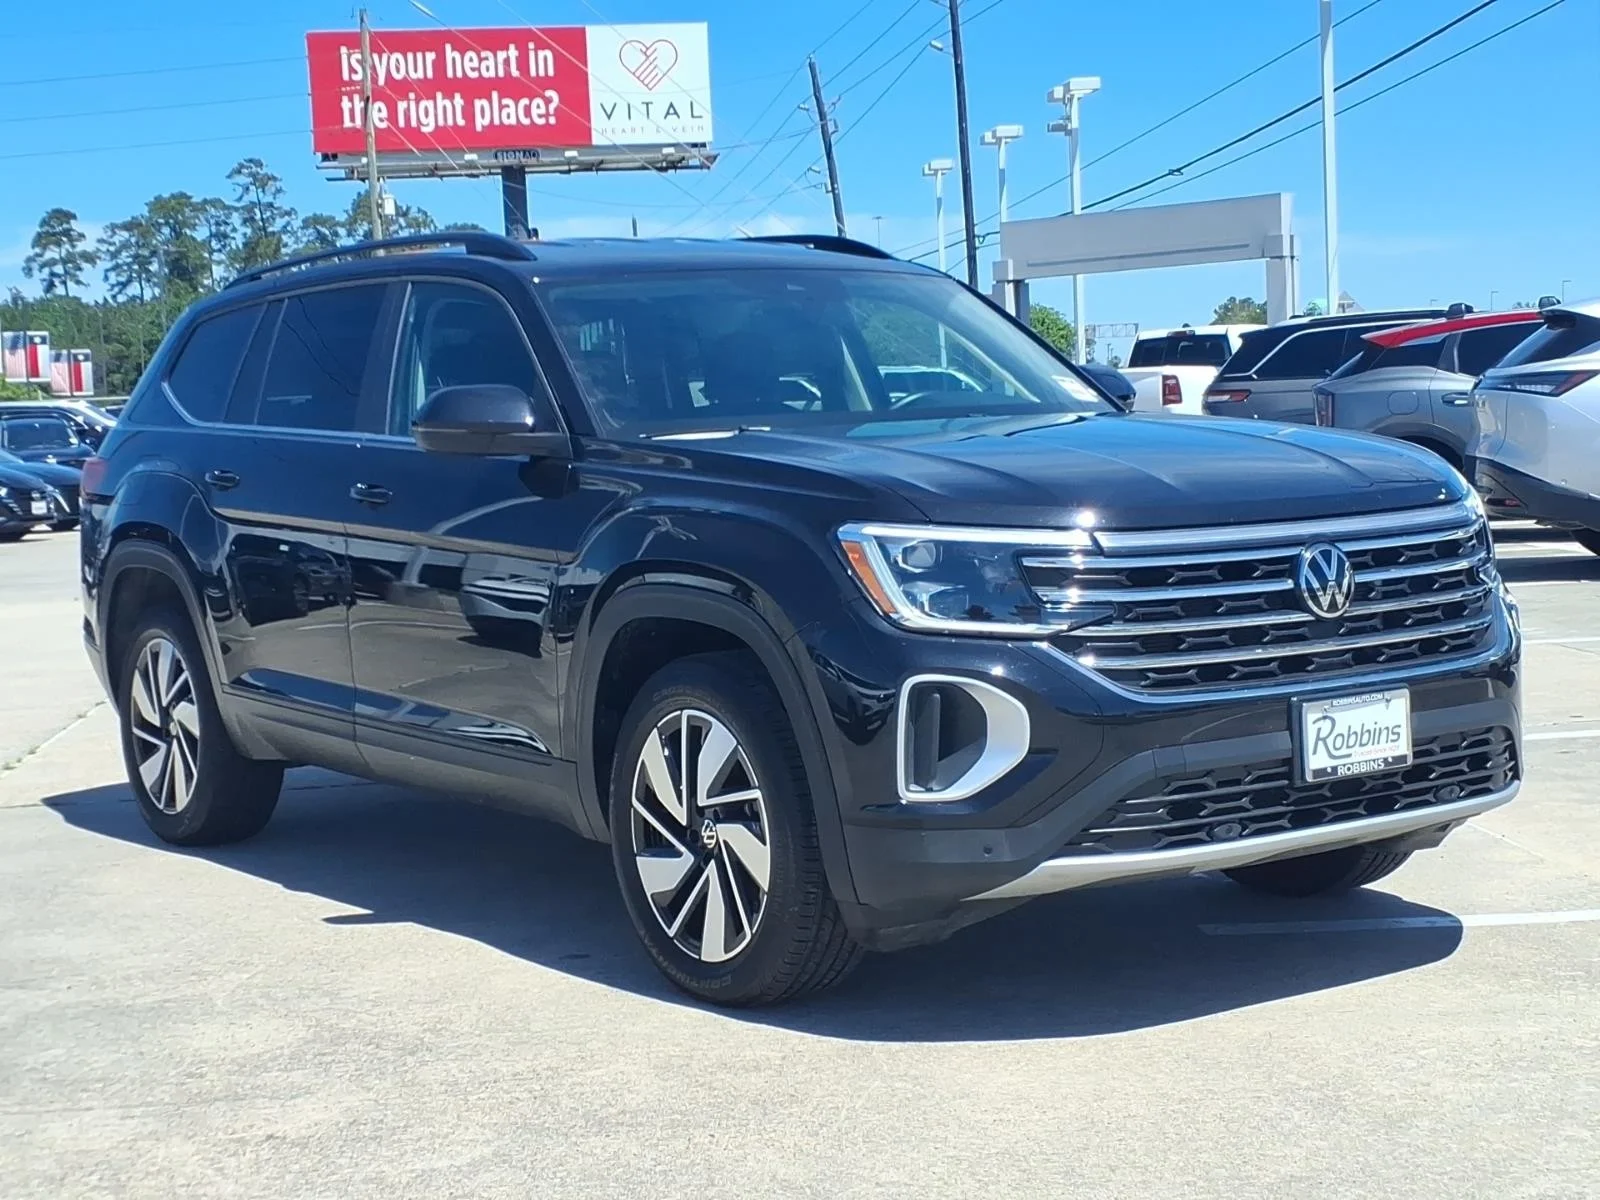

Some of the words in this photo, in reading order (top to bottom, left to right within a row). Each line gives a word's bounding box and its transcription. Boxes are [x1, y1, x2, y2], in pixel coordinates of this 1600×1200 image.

[371, 51, 436, 87] your
[444, 43, 520, 79] heart
[528, 41, 554, 77] in
[340, 93, 388, 129] the
[397, 91, 466, 133] right
[473, 89, 560, 132] place?
[600, 100, 704, 120] VITAL
[601, 126, 645, 136] HEART
[1312, 715, 1402, 760] Robbins
[1336, 758, 1385, 776] ROBBINS
